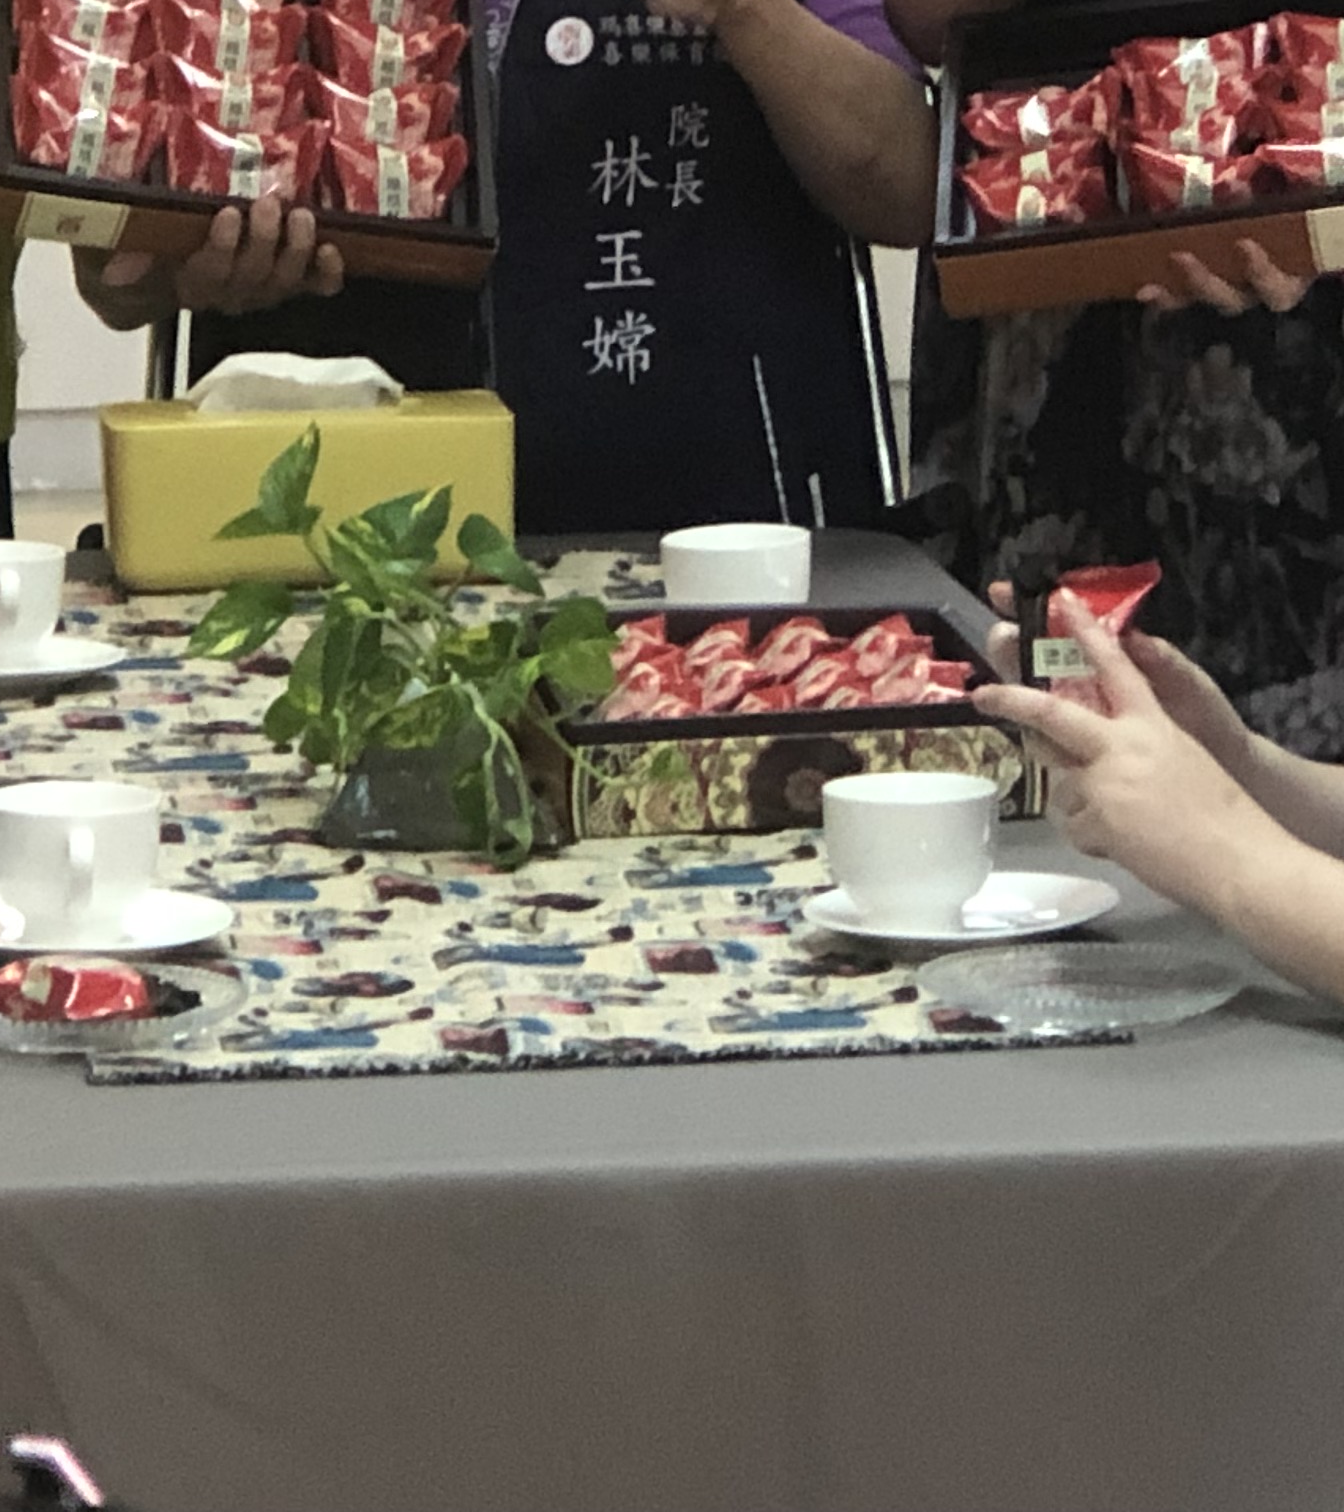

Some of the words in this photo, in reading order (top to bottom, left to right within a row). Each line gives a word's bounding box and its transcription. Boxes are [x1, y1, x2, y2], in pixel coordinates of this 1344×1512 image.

[666, 102, 711, 209] 院長
[581, 134, 661, 386] 林玉嫦
